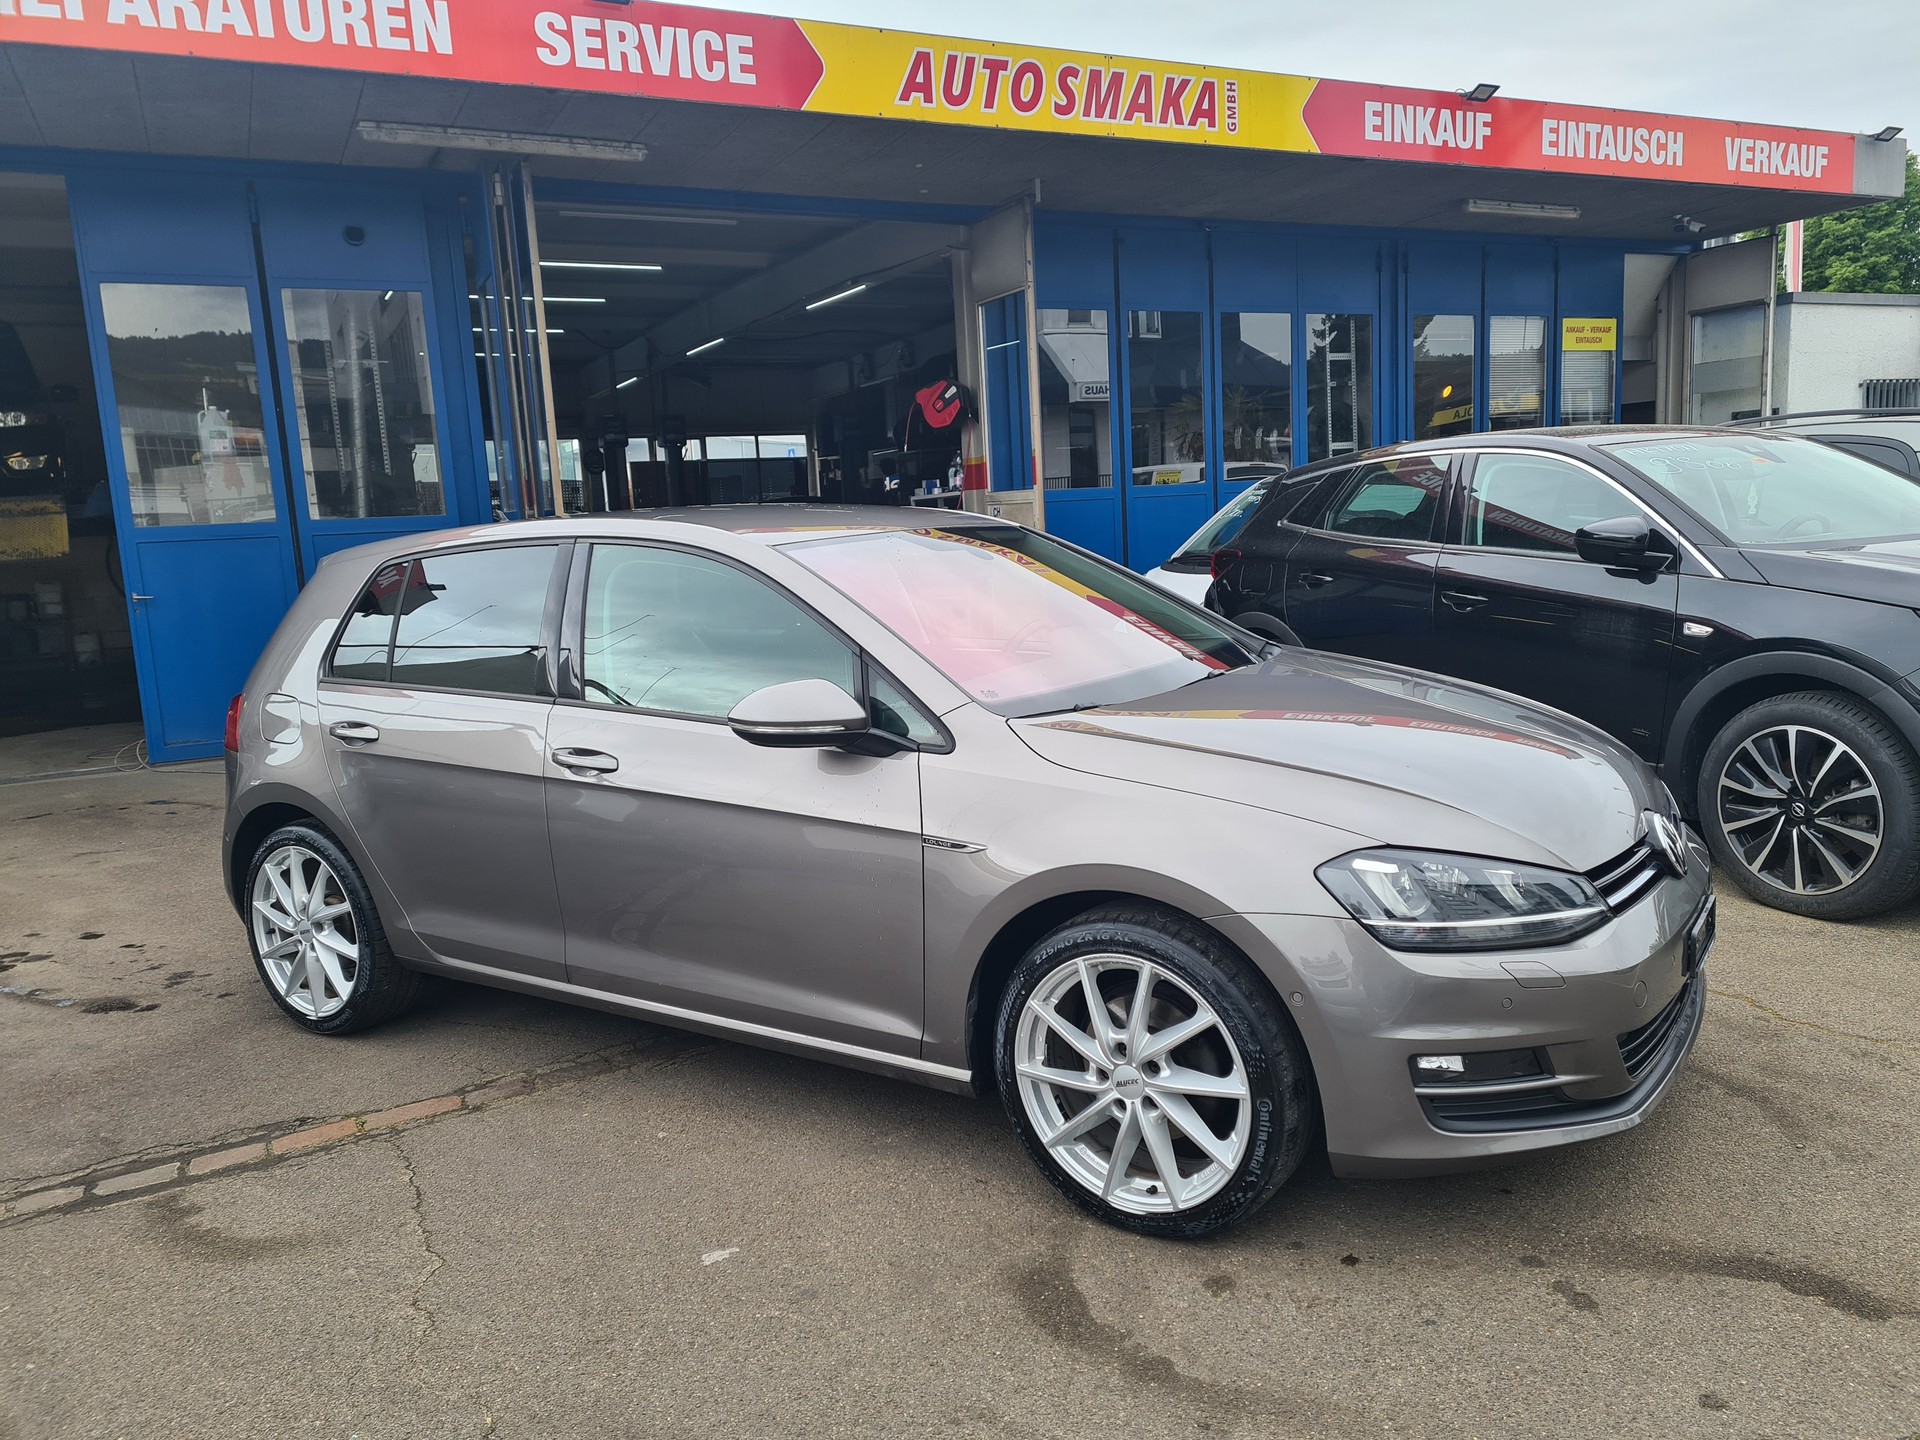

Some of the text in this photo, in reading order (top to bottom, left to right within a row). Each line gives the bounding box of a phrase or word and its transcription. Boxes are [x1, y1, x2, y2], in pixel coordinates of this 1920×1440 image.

[533, 11, 757, 85] SERVICE
[894, 47, 1219, 132] AUTO SMAKA
[1225, 80, 1238, 134] GMBH
[1364, 101, 1492, 150] EINKAUF
[1542, 118, 1685, 166] EINTAUSCH
[1725, 137, 1829, 178] VERKAUF
[1565, 326, 1585, 334] ANKAUF
[1590, 326, 1613, 334] VERKAUF
[1575, 336, 1603, 344] EINTAUSCH
[925, 838, 952, 848] LOUNGE
[1034, 939, 1074, 965] 225/40
[1076, 931, 1094, 944] ZR
[1248, 1098, 1273, 1175] Continental
